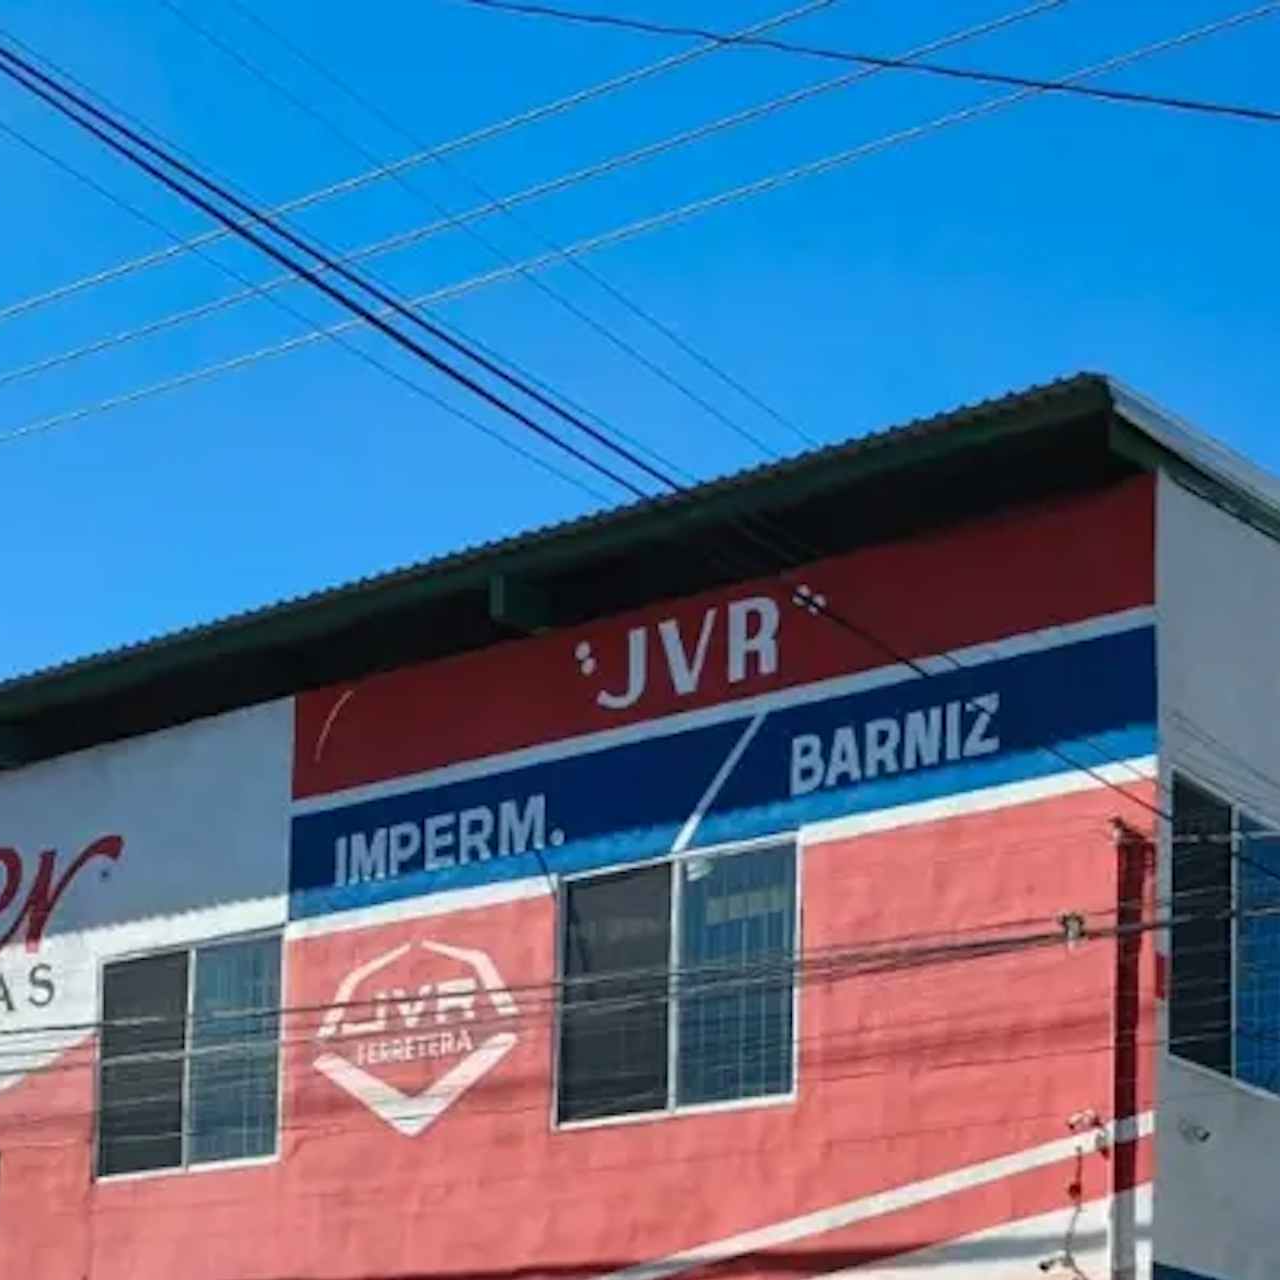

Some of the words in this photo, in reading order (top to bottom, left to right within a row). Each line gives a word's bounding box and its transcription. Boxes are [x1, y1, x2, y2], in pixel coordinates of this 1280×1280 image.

[597, 597, 780, 710] JVR
[789, 692, 1002, 797] BARNIZ
[334, 792, 566, 888] IMPERM.
[341, 977, 477, 1034] JVR
